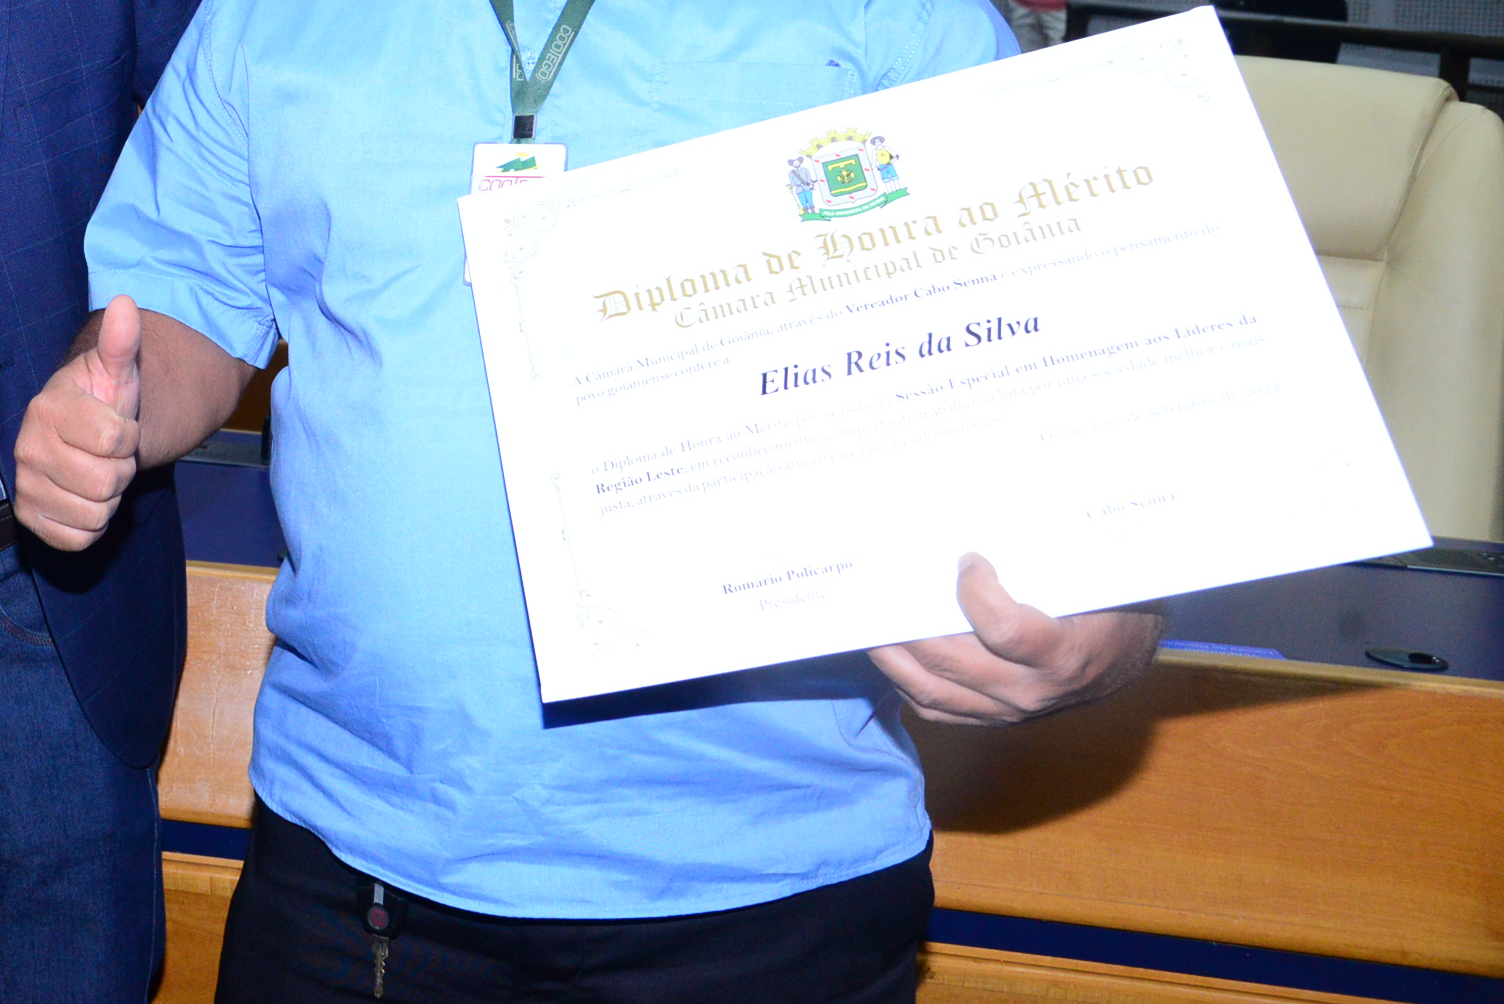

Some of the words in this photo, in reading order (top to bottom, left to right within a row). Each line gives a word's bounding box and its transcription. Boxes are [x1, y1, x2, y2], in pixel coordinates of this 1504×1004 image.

[593, 264, 752, 320] Diploma
[762, 250, 801, 274] de
[815, 216, 943, 267] Honra
[959, 202, 998, 228] ao
[1015, 166, 1153, 218] Mérito
[675, 292, 776, 328] Câmara
[787, 251, 922, 302] Municipal
[929, 246, 957, 263] de
[971, 219, 1081, 254] Goiânia
[761, 364, 832, 396] Elias
[846, 342, 906, 376] Reis
[919, 332, 952, 358] da
[965, 317, 1039, 347] Silva
[895, 381, 944, 401] Sessão
[949, 364, 1010, 388] Especial
[1016, 362, 1039, 373] em
[1042, 340, 1140, 367] Homenagem
[1145, 333, 1171, 345] aos
[1175, 320, 1234, 339] Líderes
[1239, 313, 1258, 326] da
